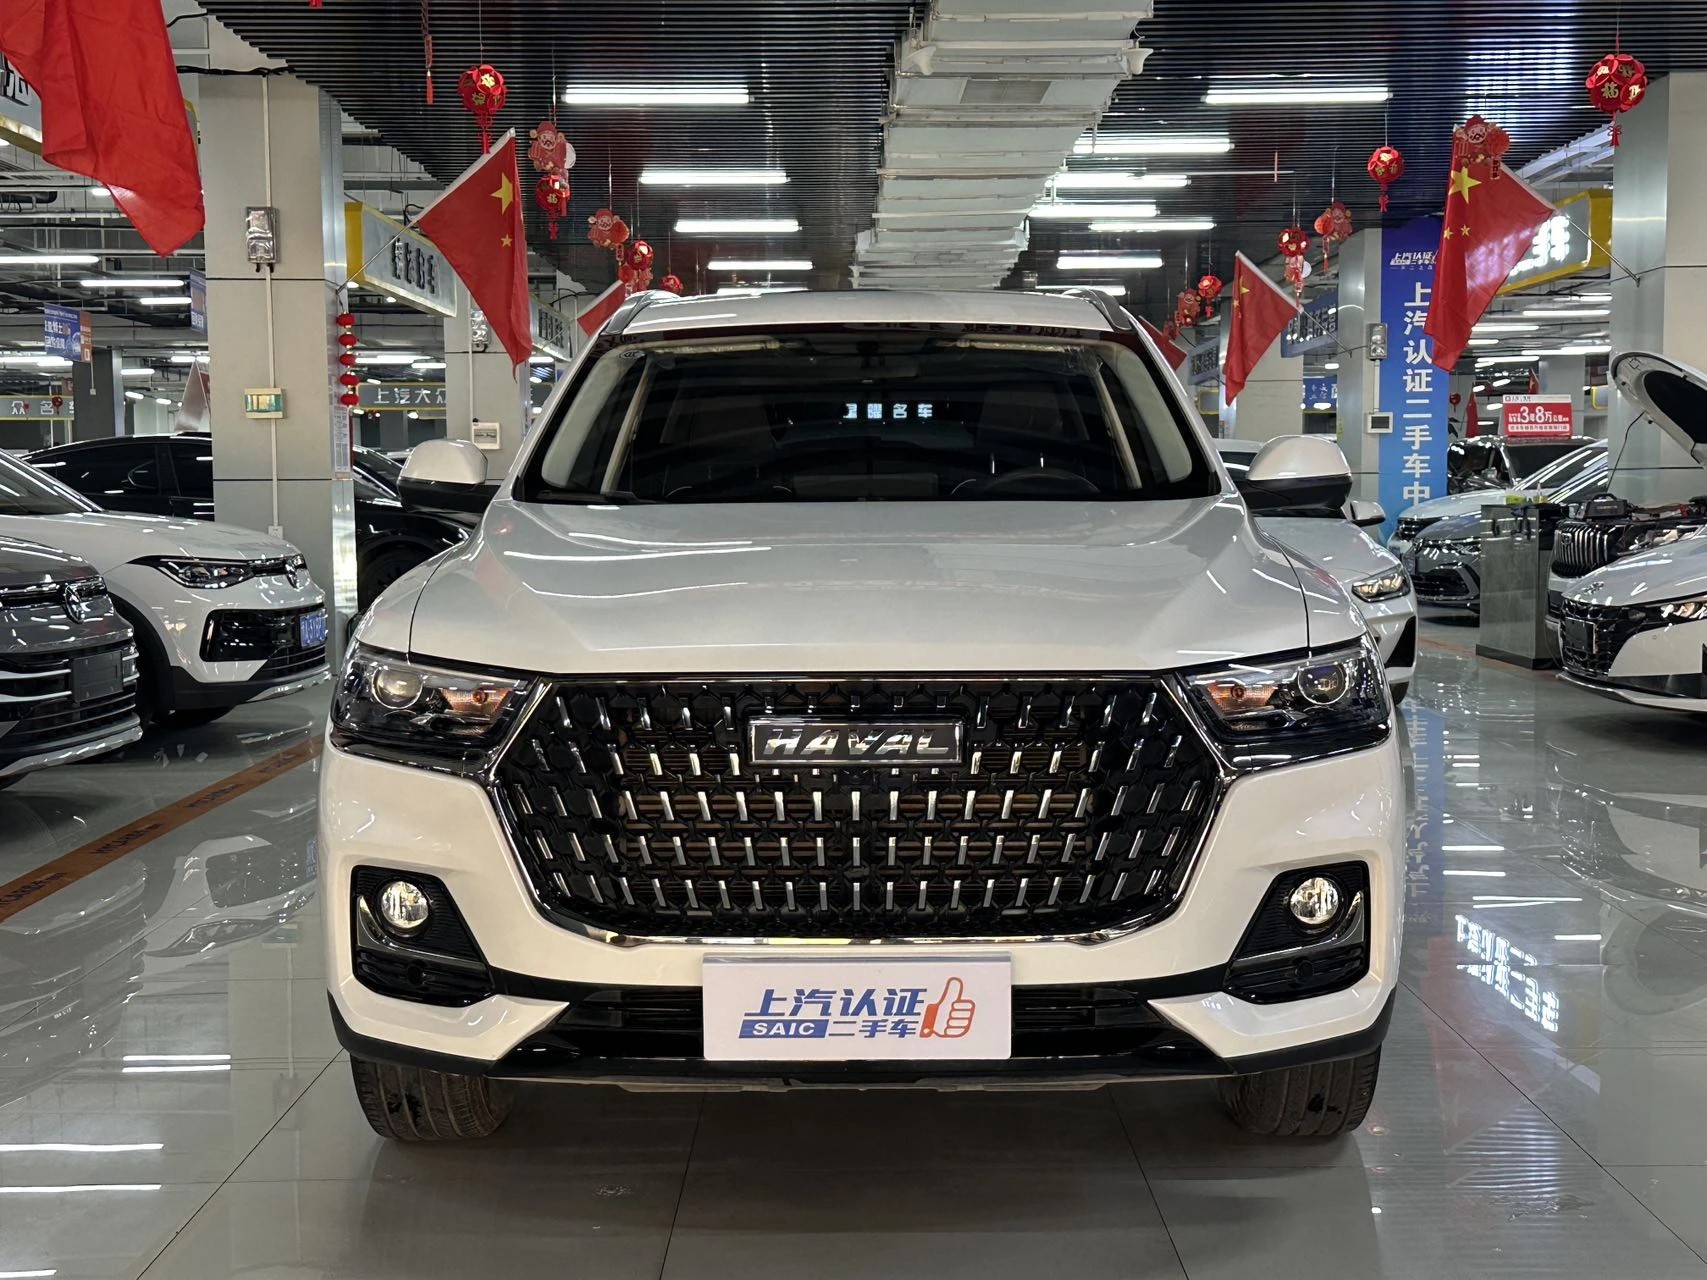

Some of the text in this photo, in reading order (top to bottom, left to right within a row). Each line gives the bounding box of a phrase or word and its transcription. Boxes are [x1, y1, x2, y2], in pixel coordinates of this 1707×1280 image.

[763, 728, 949, 755] HAVAL
[743, 988, 928, 1017] 上汽认证
[751, 1019, 919, 1038] SAIC 二手车
